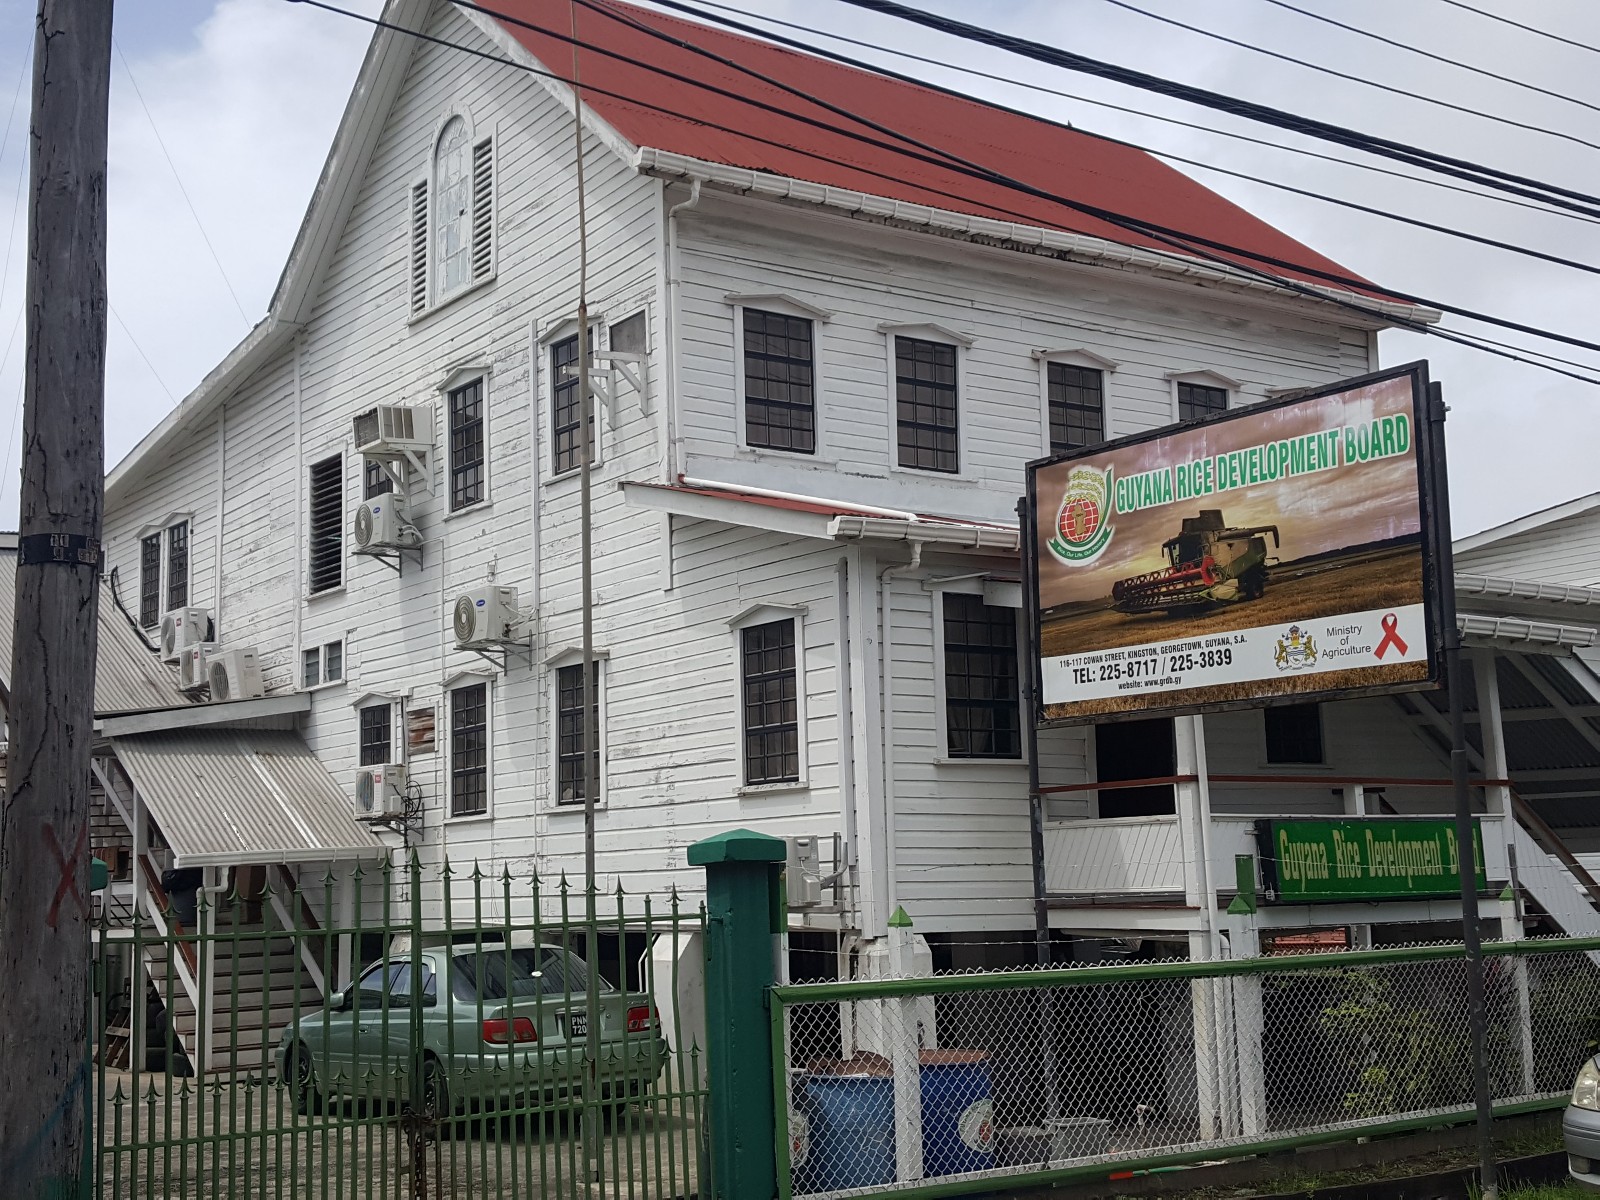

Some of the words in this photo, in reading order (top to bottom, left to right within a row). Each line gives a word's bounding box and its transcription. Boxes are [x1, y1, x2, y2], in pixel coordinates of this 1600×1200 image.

[1115, 467, 1174, 513] GUYANA
[1176, 457, 1214, 501] RICE
[1216, 429, 1340, 492] DEVELOPMENT
[1344, 414, 1409, 464] BOARD
[1326, 625, 1363, 637] Ministry
[1340, 636, 1350, 646] of
[1084, 654, 1103, 665] COWAN
[1104, 651, 1127, 662] STREET,
[1127, 647, 1159, 659] KINGSTON,
[1160, 640, 1204, 654] GEORGETOWN,
[1205, 636, 1233, 649] GUYANA,
[1234, 634, 1247, 644] S.A.
[1321, 645, 1372, 659] Agriculture
[1073, 667, 1096, 684] TEL:
[1099, 658, 1158, 681] 225-8717
[1169, 648, 1232, 672] 225-3839
[1118, 681, 1143, 690] website:
[1144, 676, 1182, 687] www.grdb.gy
[1279, 829, 1330, 893] Guyana
[1332, 829, 1362, 879] Rice
[1365, 828, 1444, 889] Development
